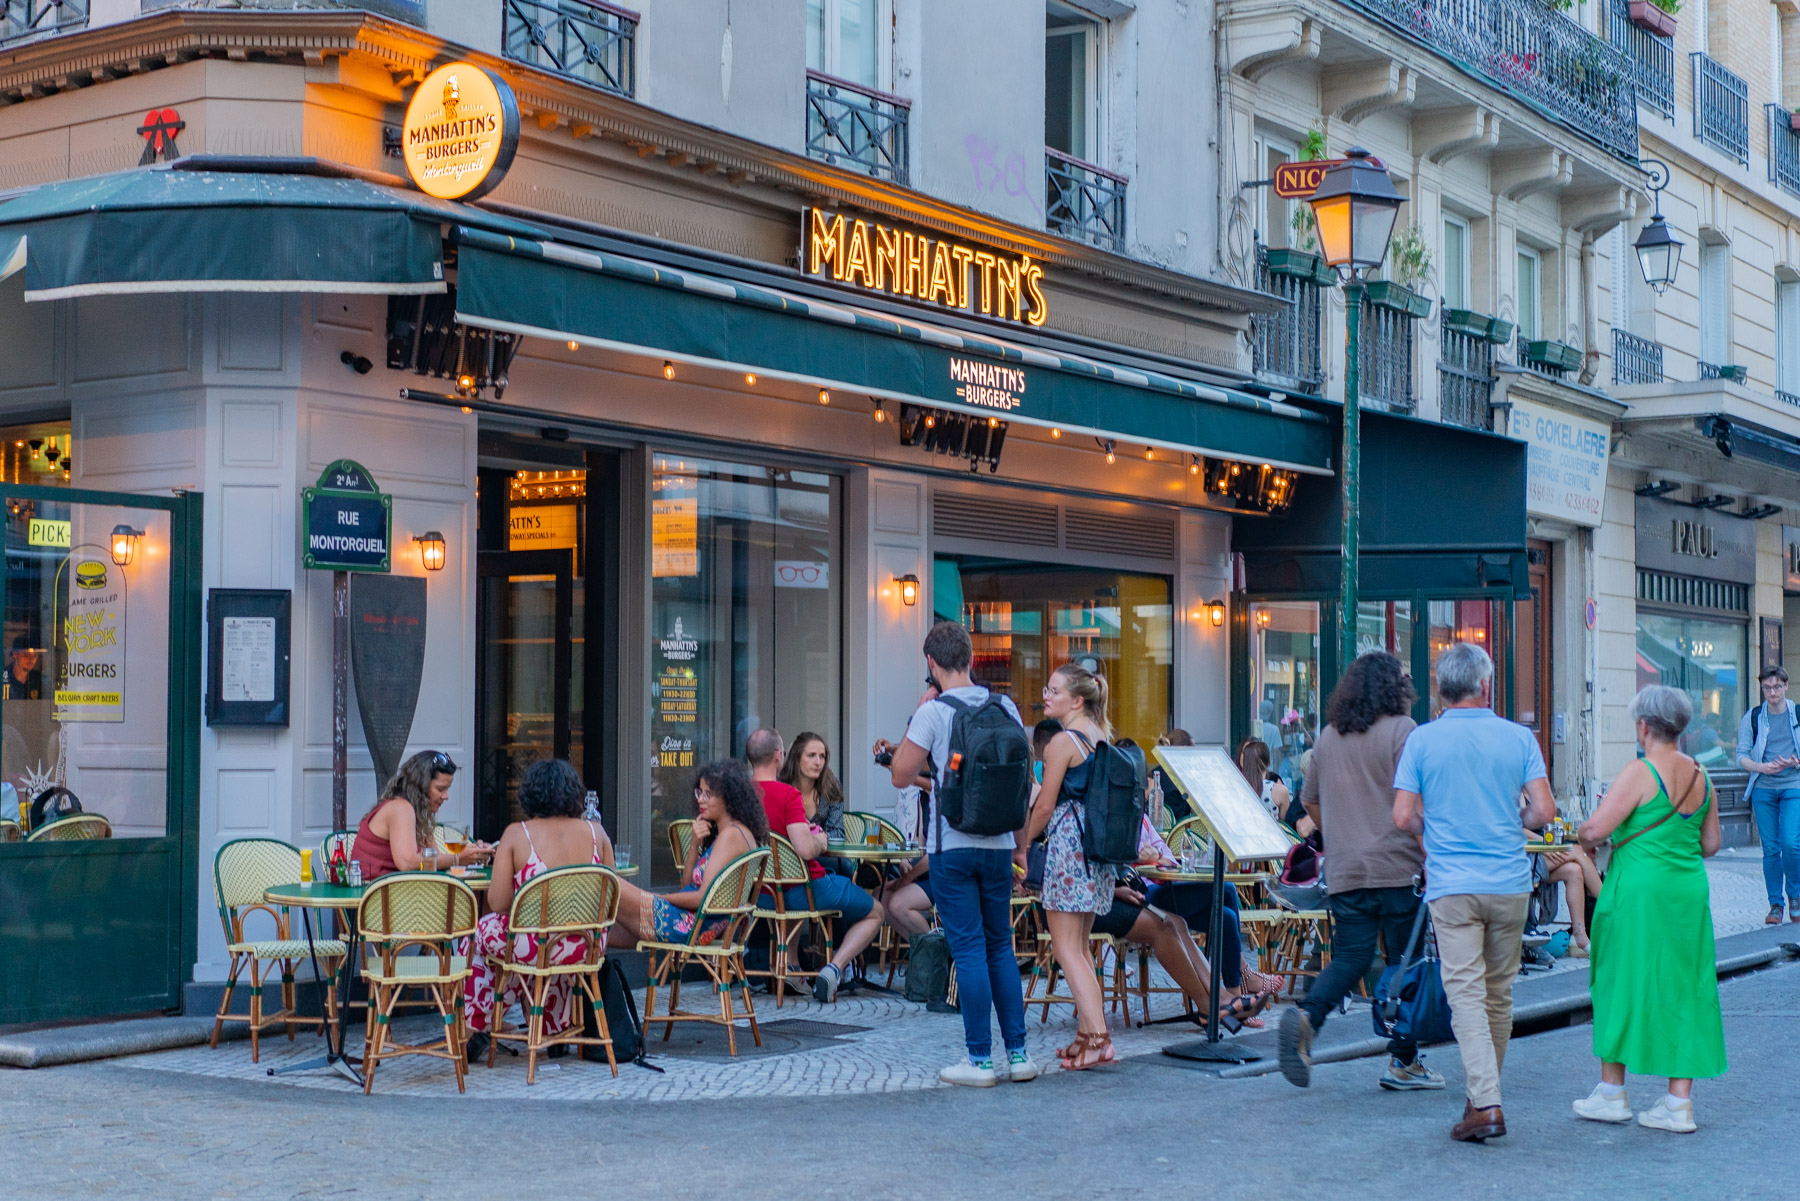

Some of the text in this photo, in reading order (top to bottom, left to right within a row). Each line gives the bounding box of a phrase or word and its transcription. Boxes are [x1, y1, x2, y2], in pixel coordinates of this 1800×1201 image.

[409, 113, 497, 147] MANHATTN'S
[426, 138, 480, 160] BURGERS
[1283, 168, 1326, 190] NIC
[811, 207, 1047, 327] MANHATTN'S
[950, 357, 1025, 393] MANHATTN'S
[965, 384, 1012, 410] BURGERS
[1535, 416, 1606, 459] GOKELAERE
[1563, 471, 1591, 492] CENTRAL
[337, 510, 360, 526] RUE
[510, 514, 541, 529] ATTN'S
[309, 534, 386, 554] MONTORGUEIL
[1673, 518, 1719, 560] PAUL
[89, 593, 118, 606] GRILLED
[64, 607, 106, 636] NEW
[64, 625, 117, 655] YORK
[660, 639, 698, 652] MANHATTN'S
[667, 651, 691, 660] BURGERS
[61, 663, 117, 679] BURGERS
[660, 751, 677, 768] TAKE
[679, 751, 694, 767] OUT
